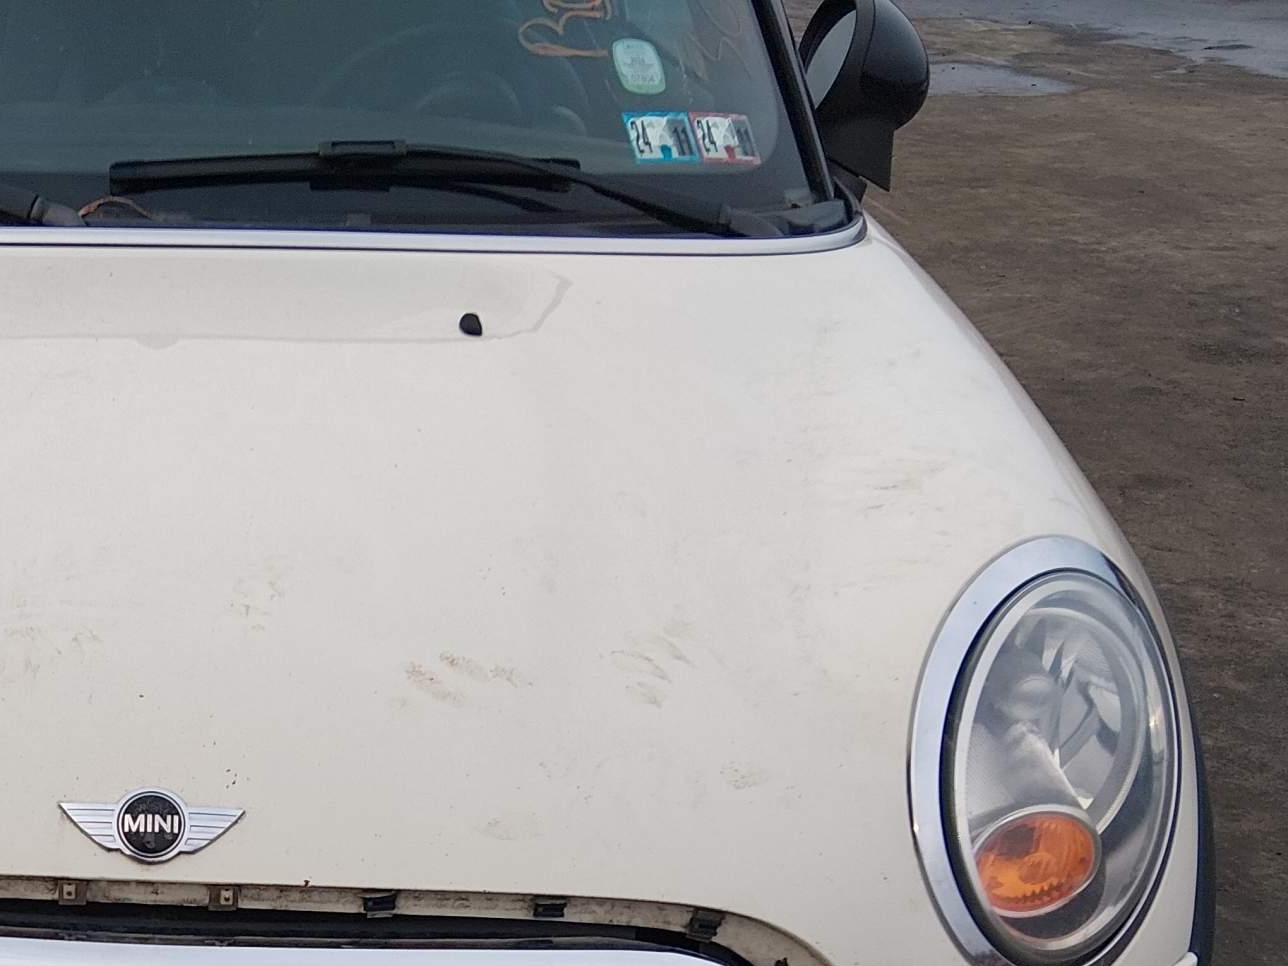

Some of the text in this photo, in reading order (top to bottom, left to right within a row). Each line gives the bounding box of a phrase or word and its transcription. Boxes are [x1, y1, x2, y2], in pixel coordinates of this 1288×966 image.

[630, 120, 694, 156] 24 11
[696, 120, 718, 154] 24
[124, 814, 179, 833] MINI
